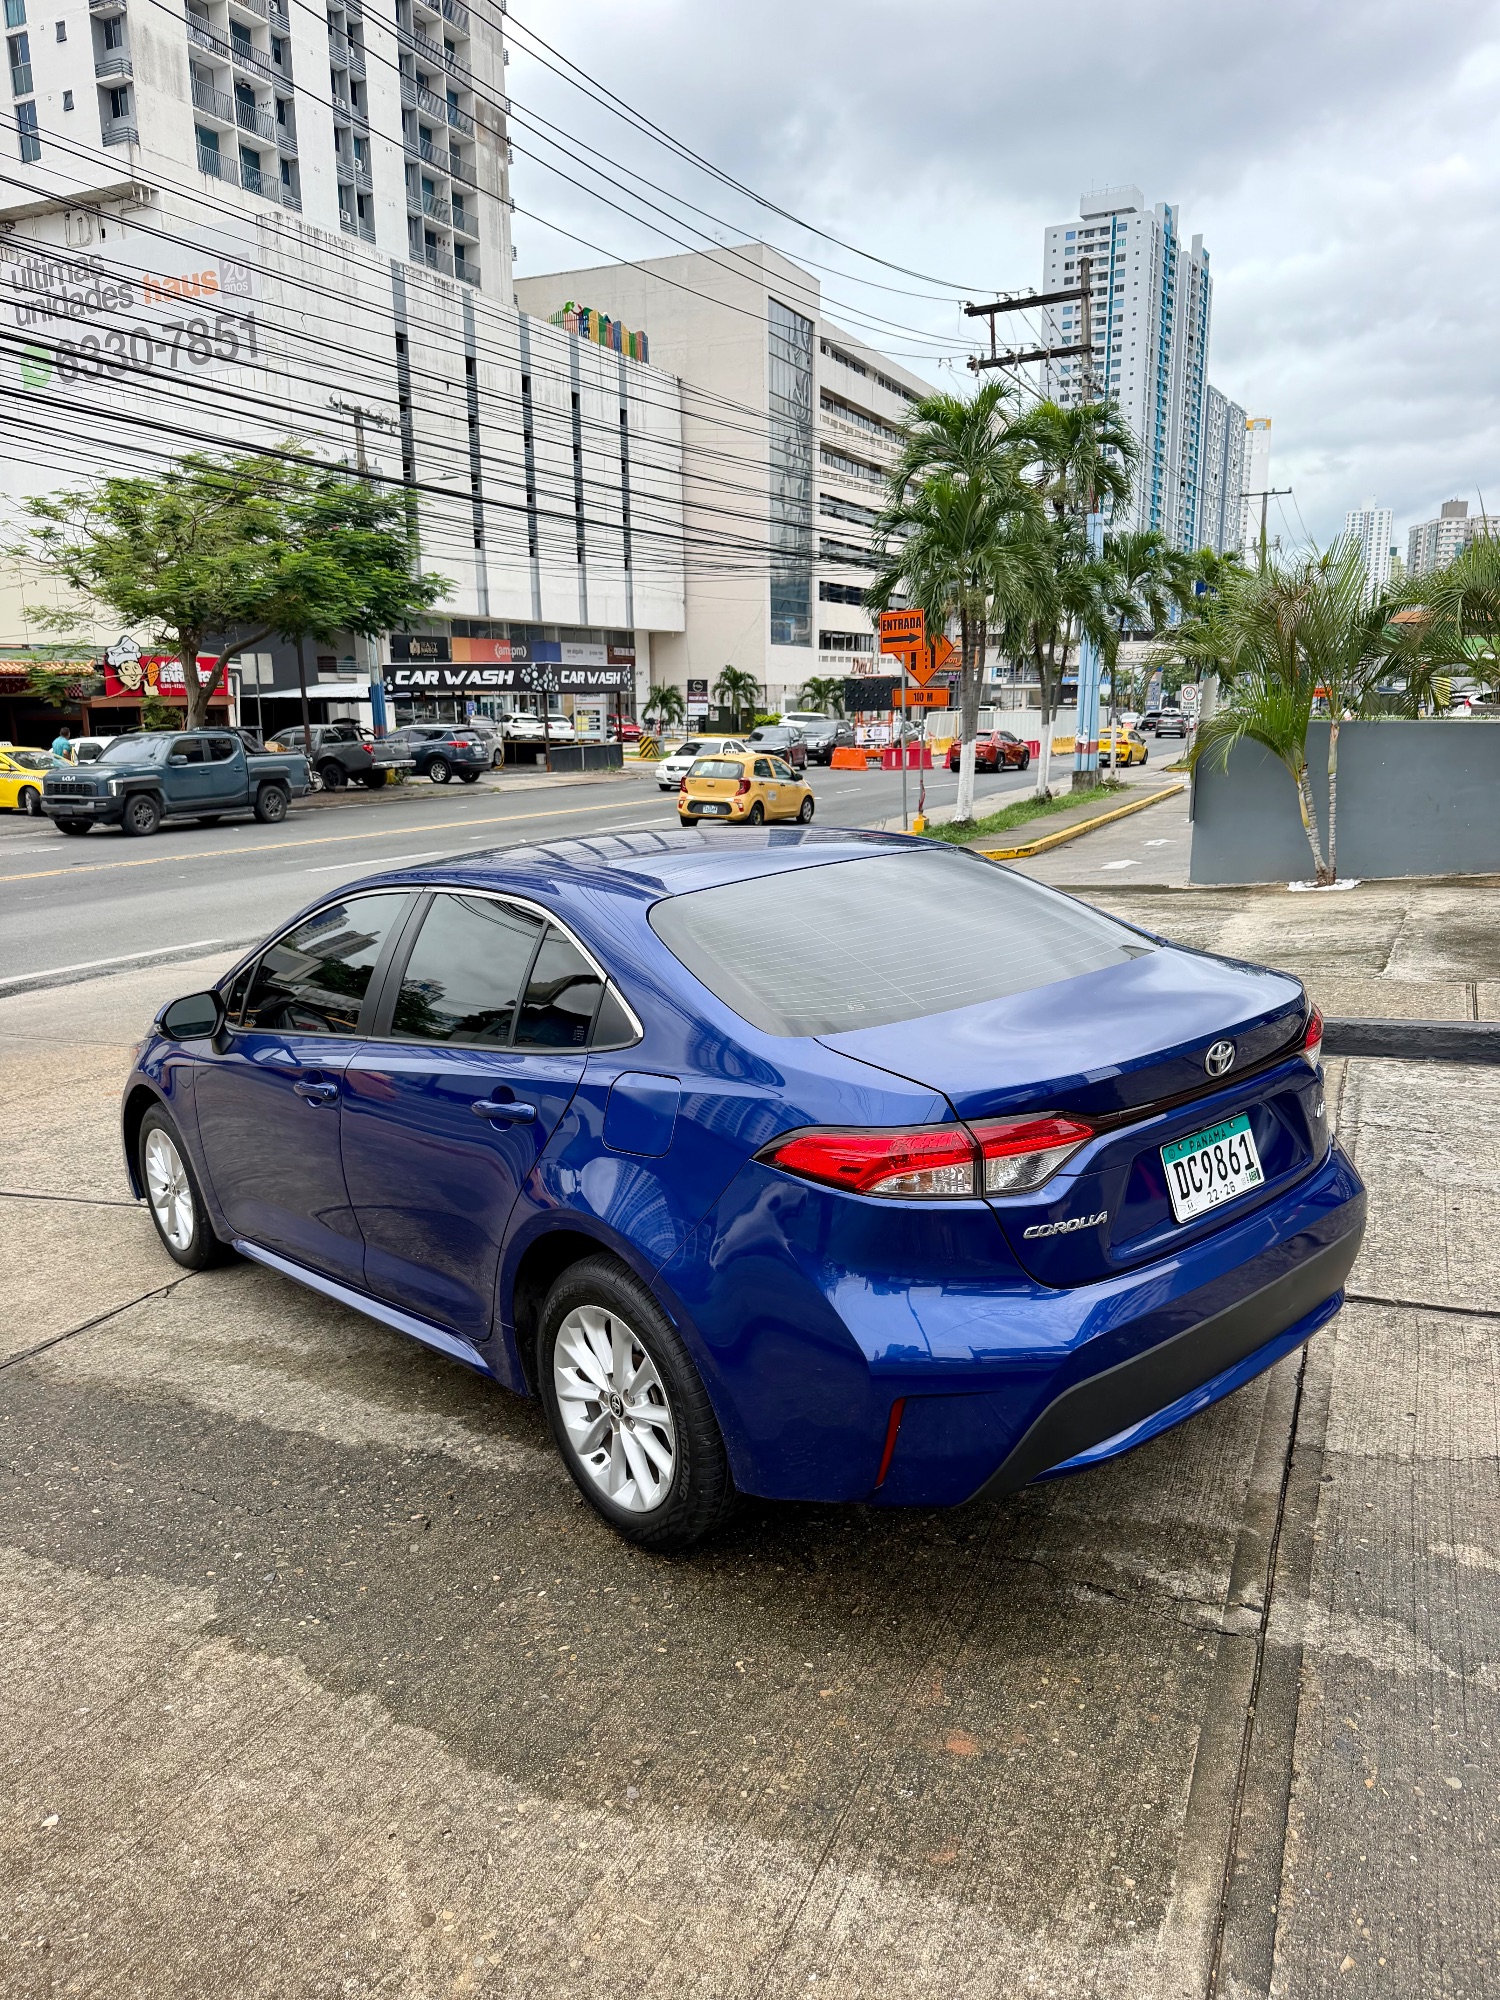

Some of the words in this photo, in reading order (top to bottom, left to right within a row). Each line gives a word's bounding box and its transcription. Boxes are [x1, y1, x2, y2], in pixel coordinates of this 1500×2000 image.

[223, 260, 247, 284] 20
[143, 270, 219, 304] haus
[224, 276, 249, 293] años
[14, 279, 134, 326] unidades
[55, 311, 259, 384] 6330-7851
[882, 617, 922, 631] ENTRADA
[395, 670, 440, 685] CAR
[443, 670, 515, 685] WASH
[560, 670, 585, 684] CAR
[586, 671, 621, 684] WASH
[926, 692, 934, 702] M
[1189, 1127, 1227, 1152] PANAMA
[1172, 1133, 1255, 1200] DC9861
[1023, 1210, 1108, 1239] COROLLA
